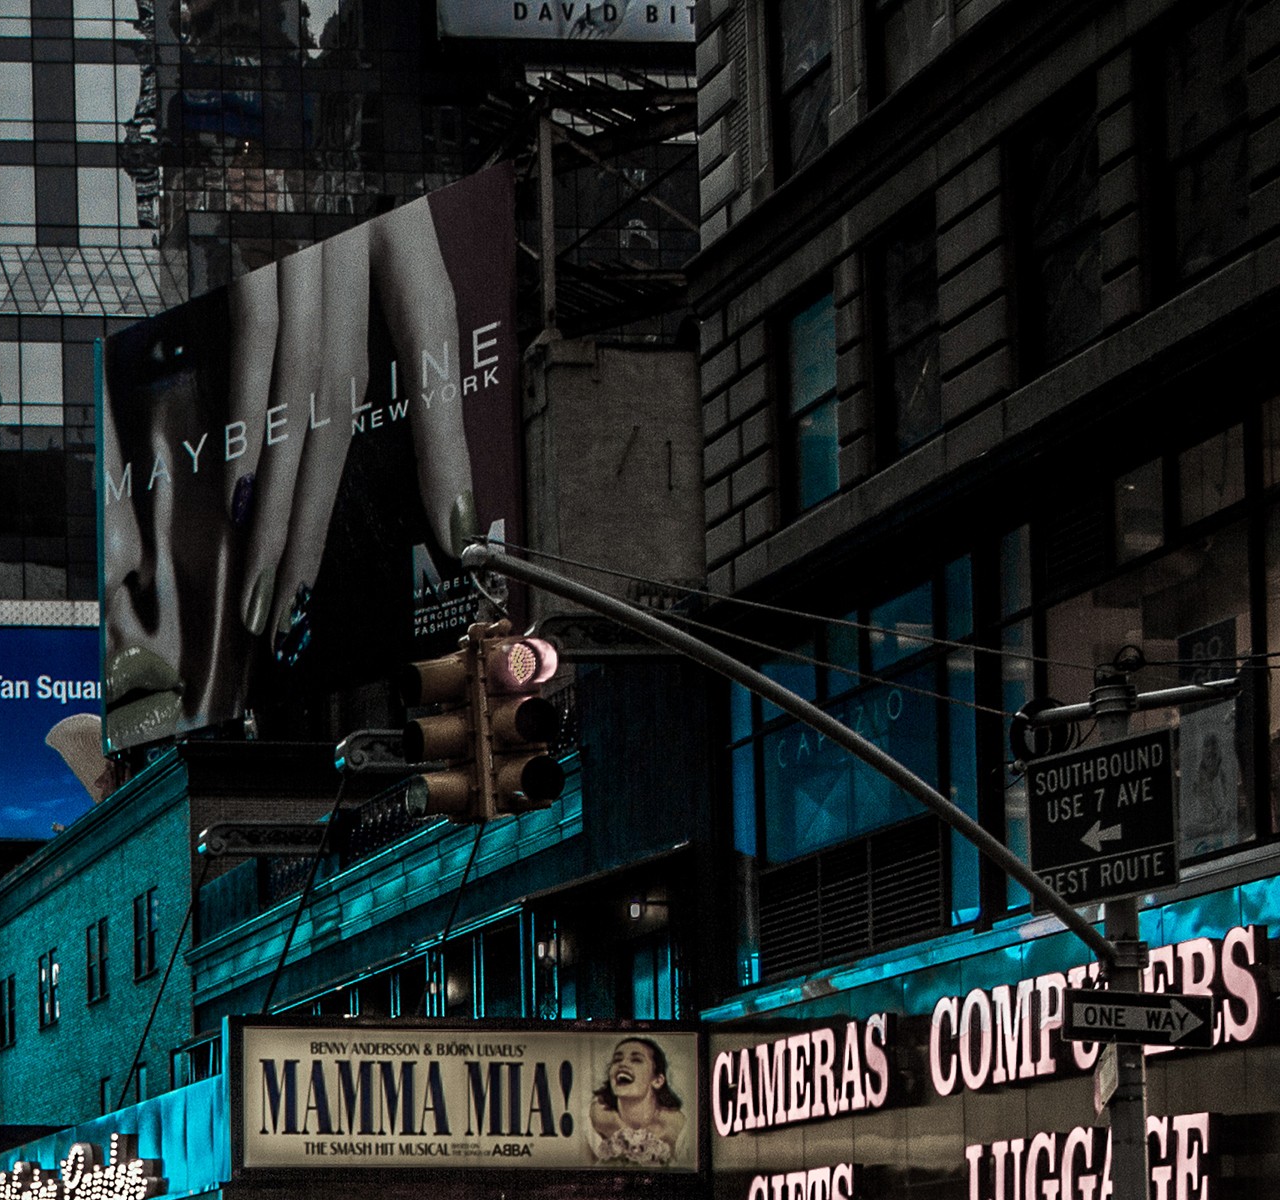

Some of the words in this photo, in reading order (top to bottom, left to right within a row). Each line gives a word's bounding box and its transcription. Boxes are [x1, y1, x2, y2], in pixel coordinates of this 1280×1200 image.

[513, 2, 618, 22] DAVID
[105, 320, 502, 507] MAYBELLINE
[351, 398, 411, 436] NEW
[421, 366, 501, 412] YORK
[414, 615, 467, 637] FASHION
[776, 687, 903, 769] CAPZIO
[1035, 742, 1164, 797] SOUTHBOUND
[1046, 793, 1085, 825] USE
[1093, 788, 1106, 813] 7
[1116, 776, 1155, 808] AVE
[1099, 851, 1166, 888] ROUTE
[929, 924, 1260, 1097] COMPUERS
[1084, 1006, 1126, 1028] ONE
[1145, 1009, 1190, 1030] WAY
[310, 1041, 349, 1055] BENNY
[351, 1042, 420, 1056] ANDERSSON
[423, 1043, 433, 1055] &
[436, 1040, 474, 1057] BJÖRN
[258, 1058, 453, 1137] MAMMA
[464, 1059, 574, 1139] MIA!
[712, 1012, 889, 1138] CAMERAS
[303, 1142, 328, 1156] THE
[329, 1142, 372, 1156] SMASH
[375, 1143, 395, 1156] HIT
[398, 1143, 452, 1157] MUSICAL
